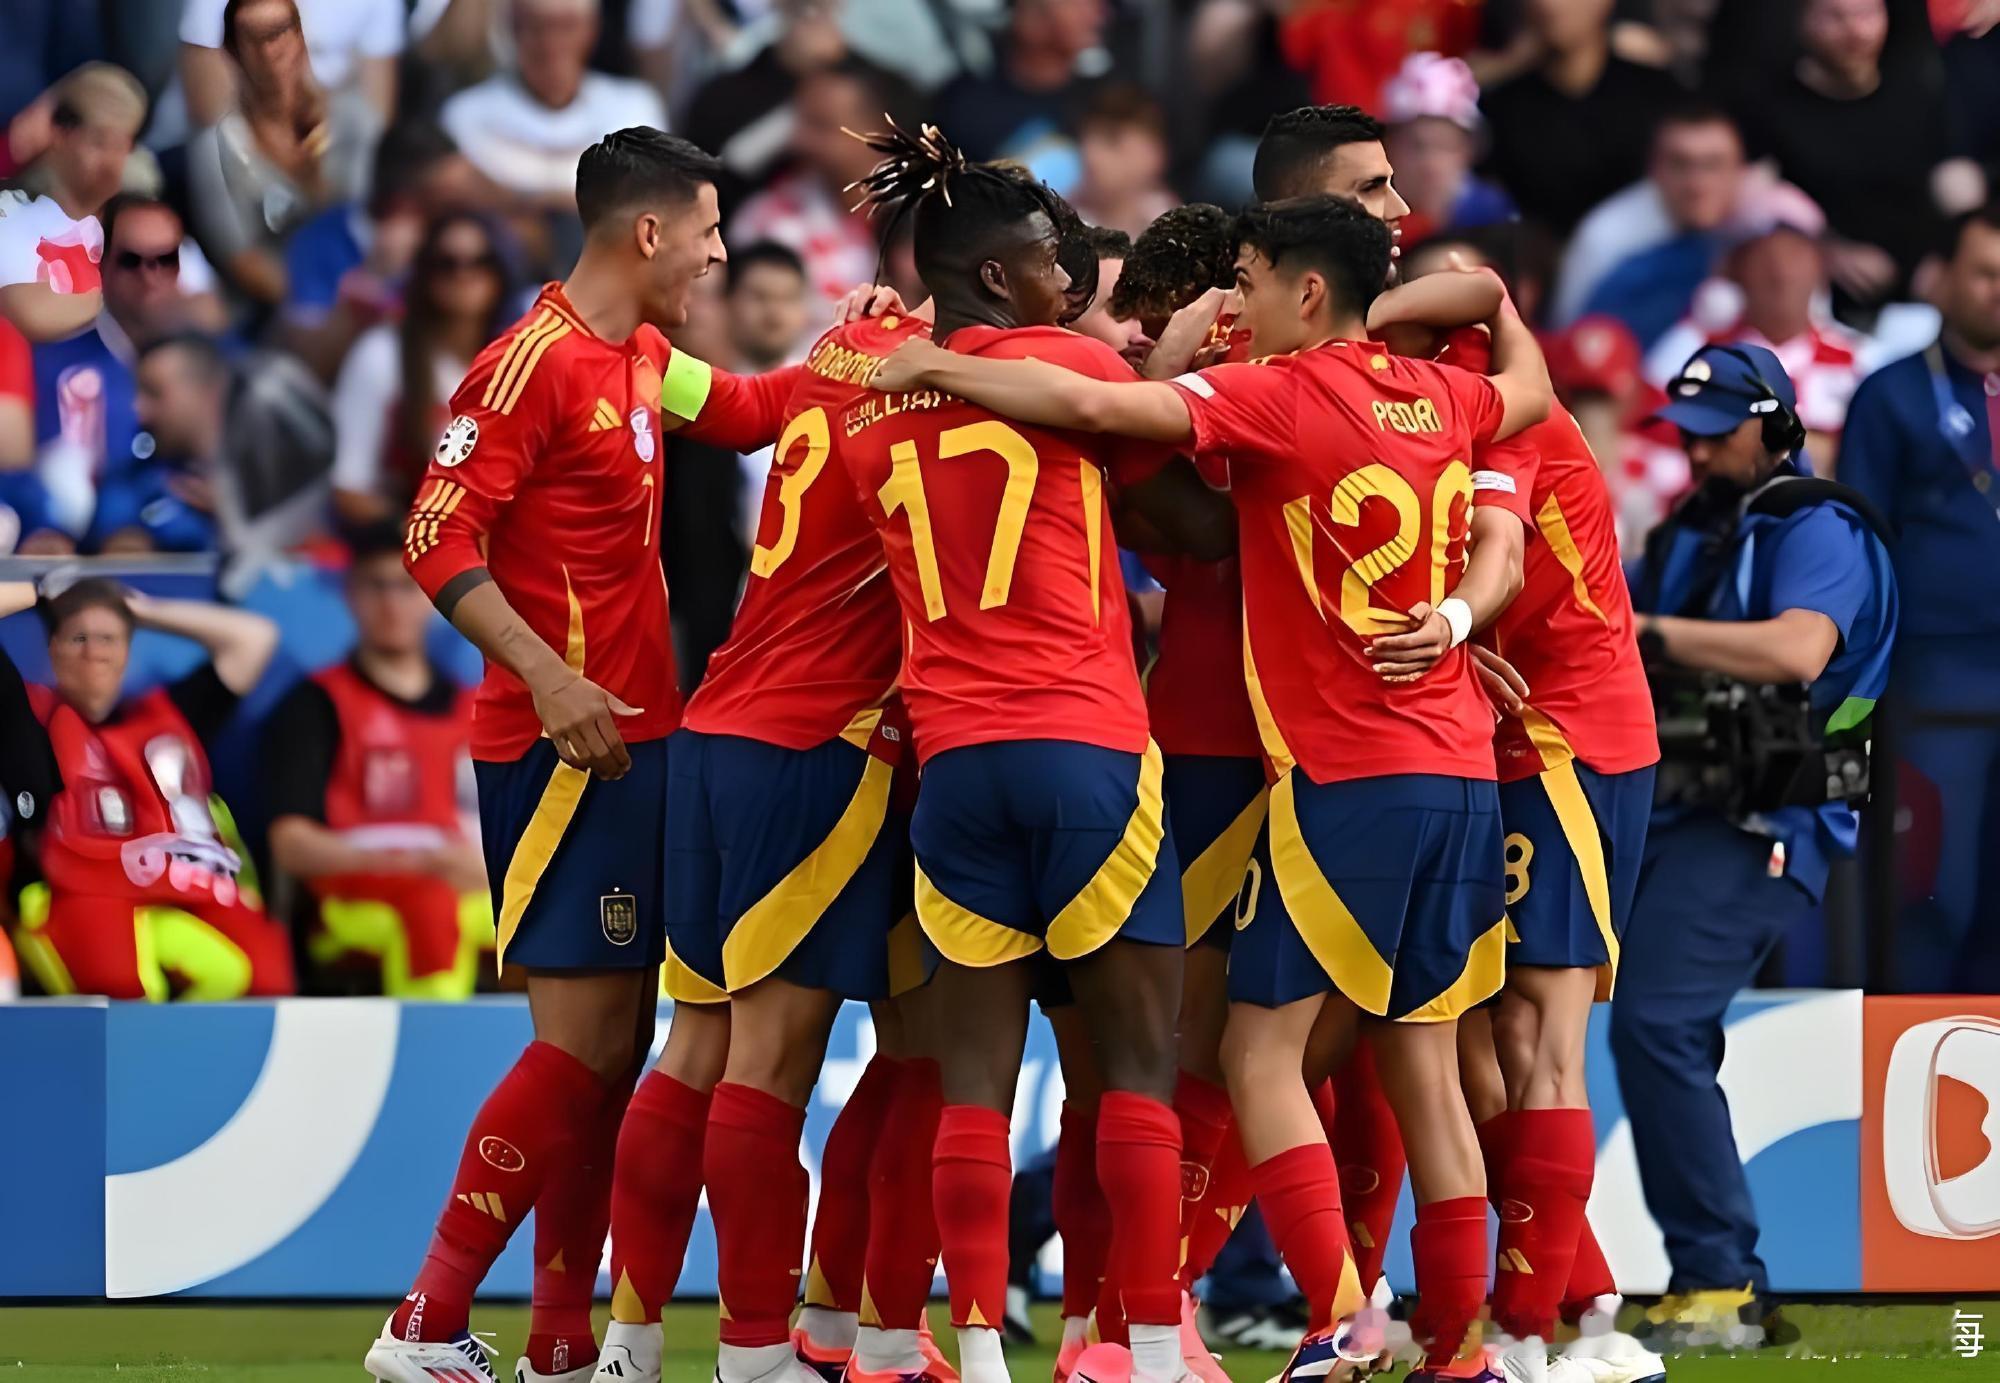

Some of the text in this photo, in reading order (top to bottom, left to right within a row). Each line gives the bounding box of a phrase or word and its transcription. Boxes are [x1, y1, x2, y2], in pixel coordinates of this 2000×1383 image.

[750, 406, 830, 579] 3
[878, 420, 1039, 622] 17
[1332, 460, 1474, 636] 20
